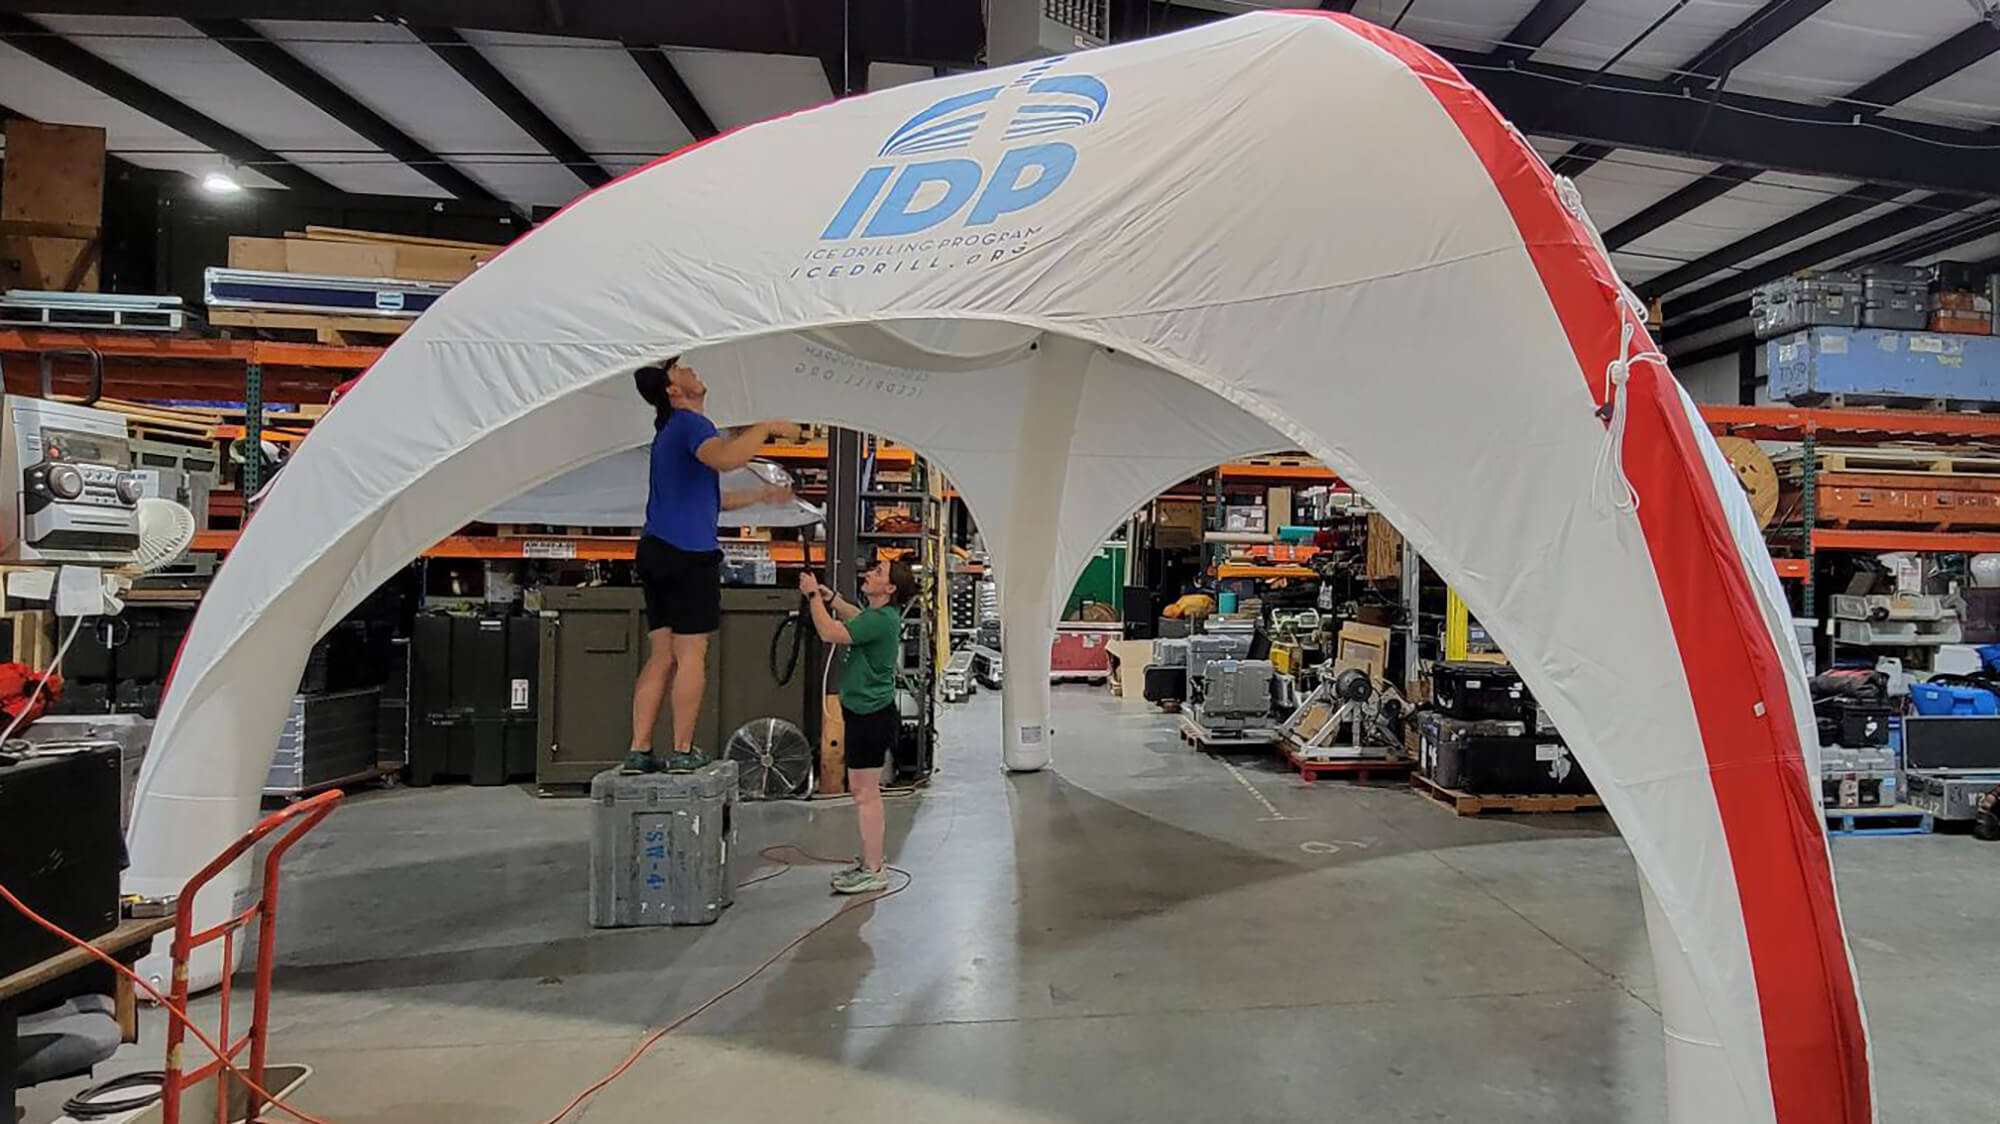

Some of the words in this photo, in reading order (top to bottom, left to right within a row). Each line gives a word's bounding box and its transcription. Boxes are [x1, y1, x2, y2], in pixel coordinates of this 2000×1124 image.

[819, 141, 1078, 240] IDP
[805, 248, 838, 260] ICE
[842, 239, 936, 258] DRILLING
